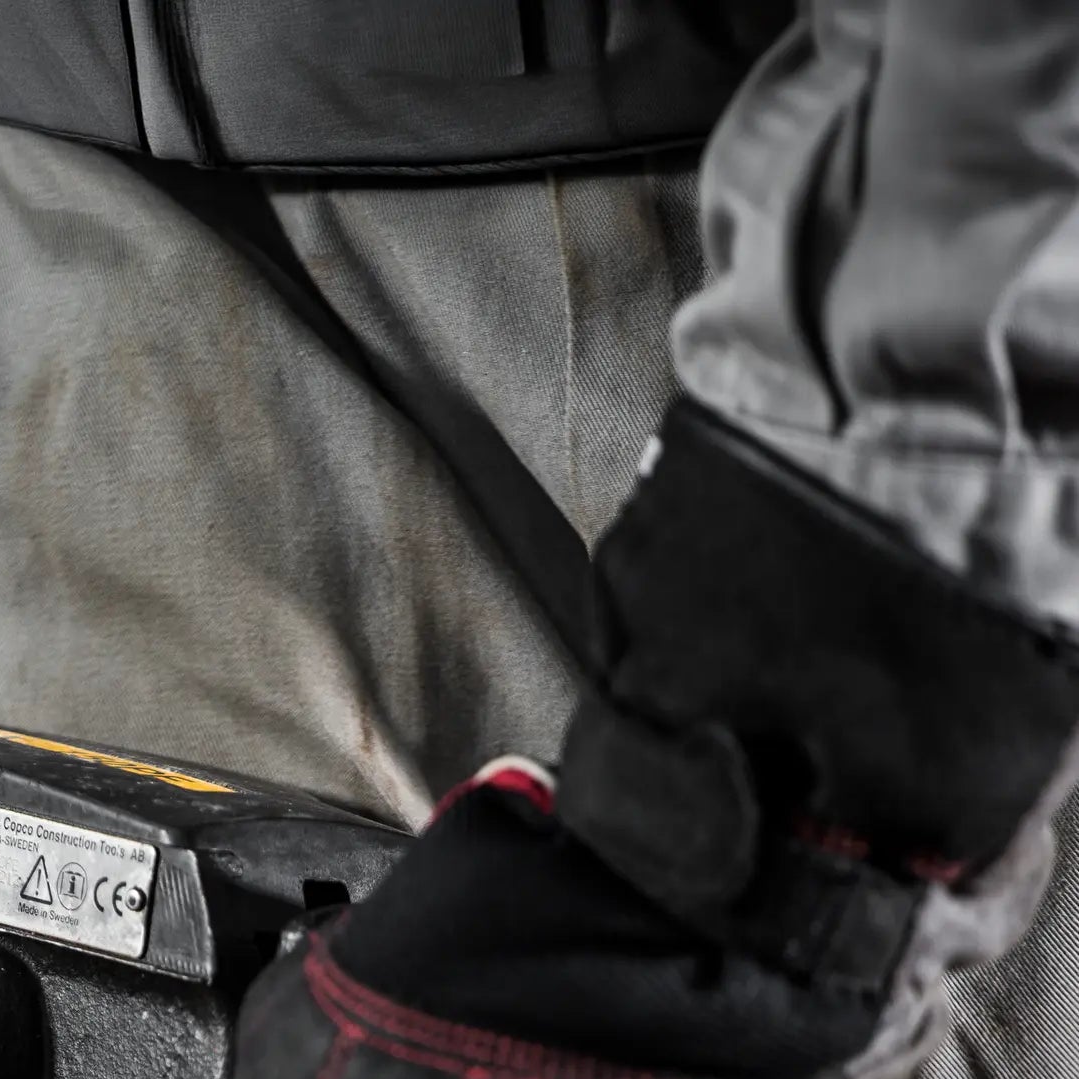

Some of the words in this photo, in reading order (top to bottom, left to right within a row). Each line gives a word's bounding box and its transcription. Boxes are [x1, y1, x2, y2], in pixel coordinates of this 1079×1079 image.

[3, 817, 33, 836] Copco
[36, 825, 97, 851] Construction
[130, 848, 145, 863] AB
[18, 902, 39, 917] Made
[49, 909, 79, 926] Sweden
